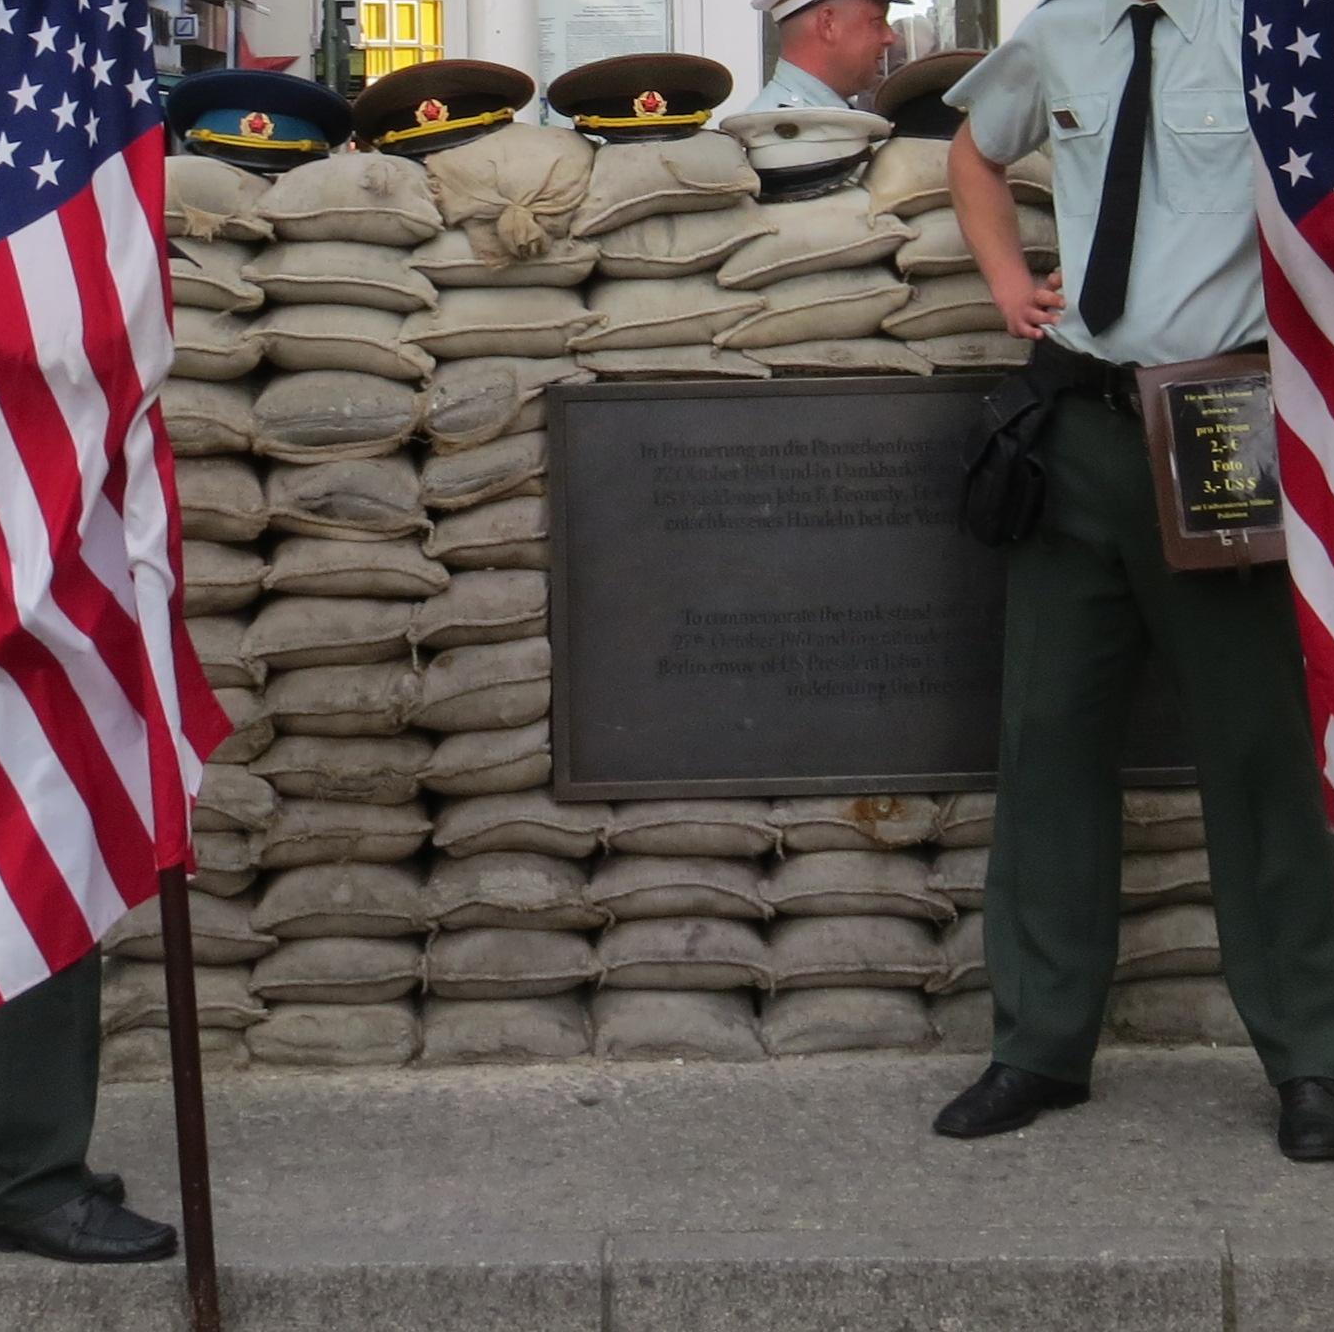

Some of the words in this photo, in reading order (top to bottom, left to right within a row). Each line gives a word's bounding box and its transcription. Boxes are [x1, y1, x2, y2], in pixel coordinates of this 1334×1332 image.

[1196, 426, 1214, 437] pro
[1216, 423, 1250, 434] Person
[639, 441, 658, 459] In
[759, 444, 780, 458] an
[783, 438, 809, 457] die
[780, 461, 812, 480] und
[1212, 460, 1243, 472] Foto
[775, 485, 812, 505] John
[787, 510, 855, 529] Handeln
[858, 509, 883, 526] bei
[886, 507, 912, 526] der
[681, 608, 703, 625] To
[820, 605, 845, 623] the
[847, 604, 884, 622] tank
[816, 628, 846, 647] and
[658, 657, 708, 676] Berlin
